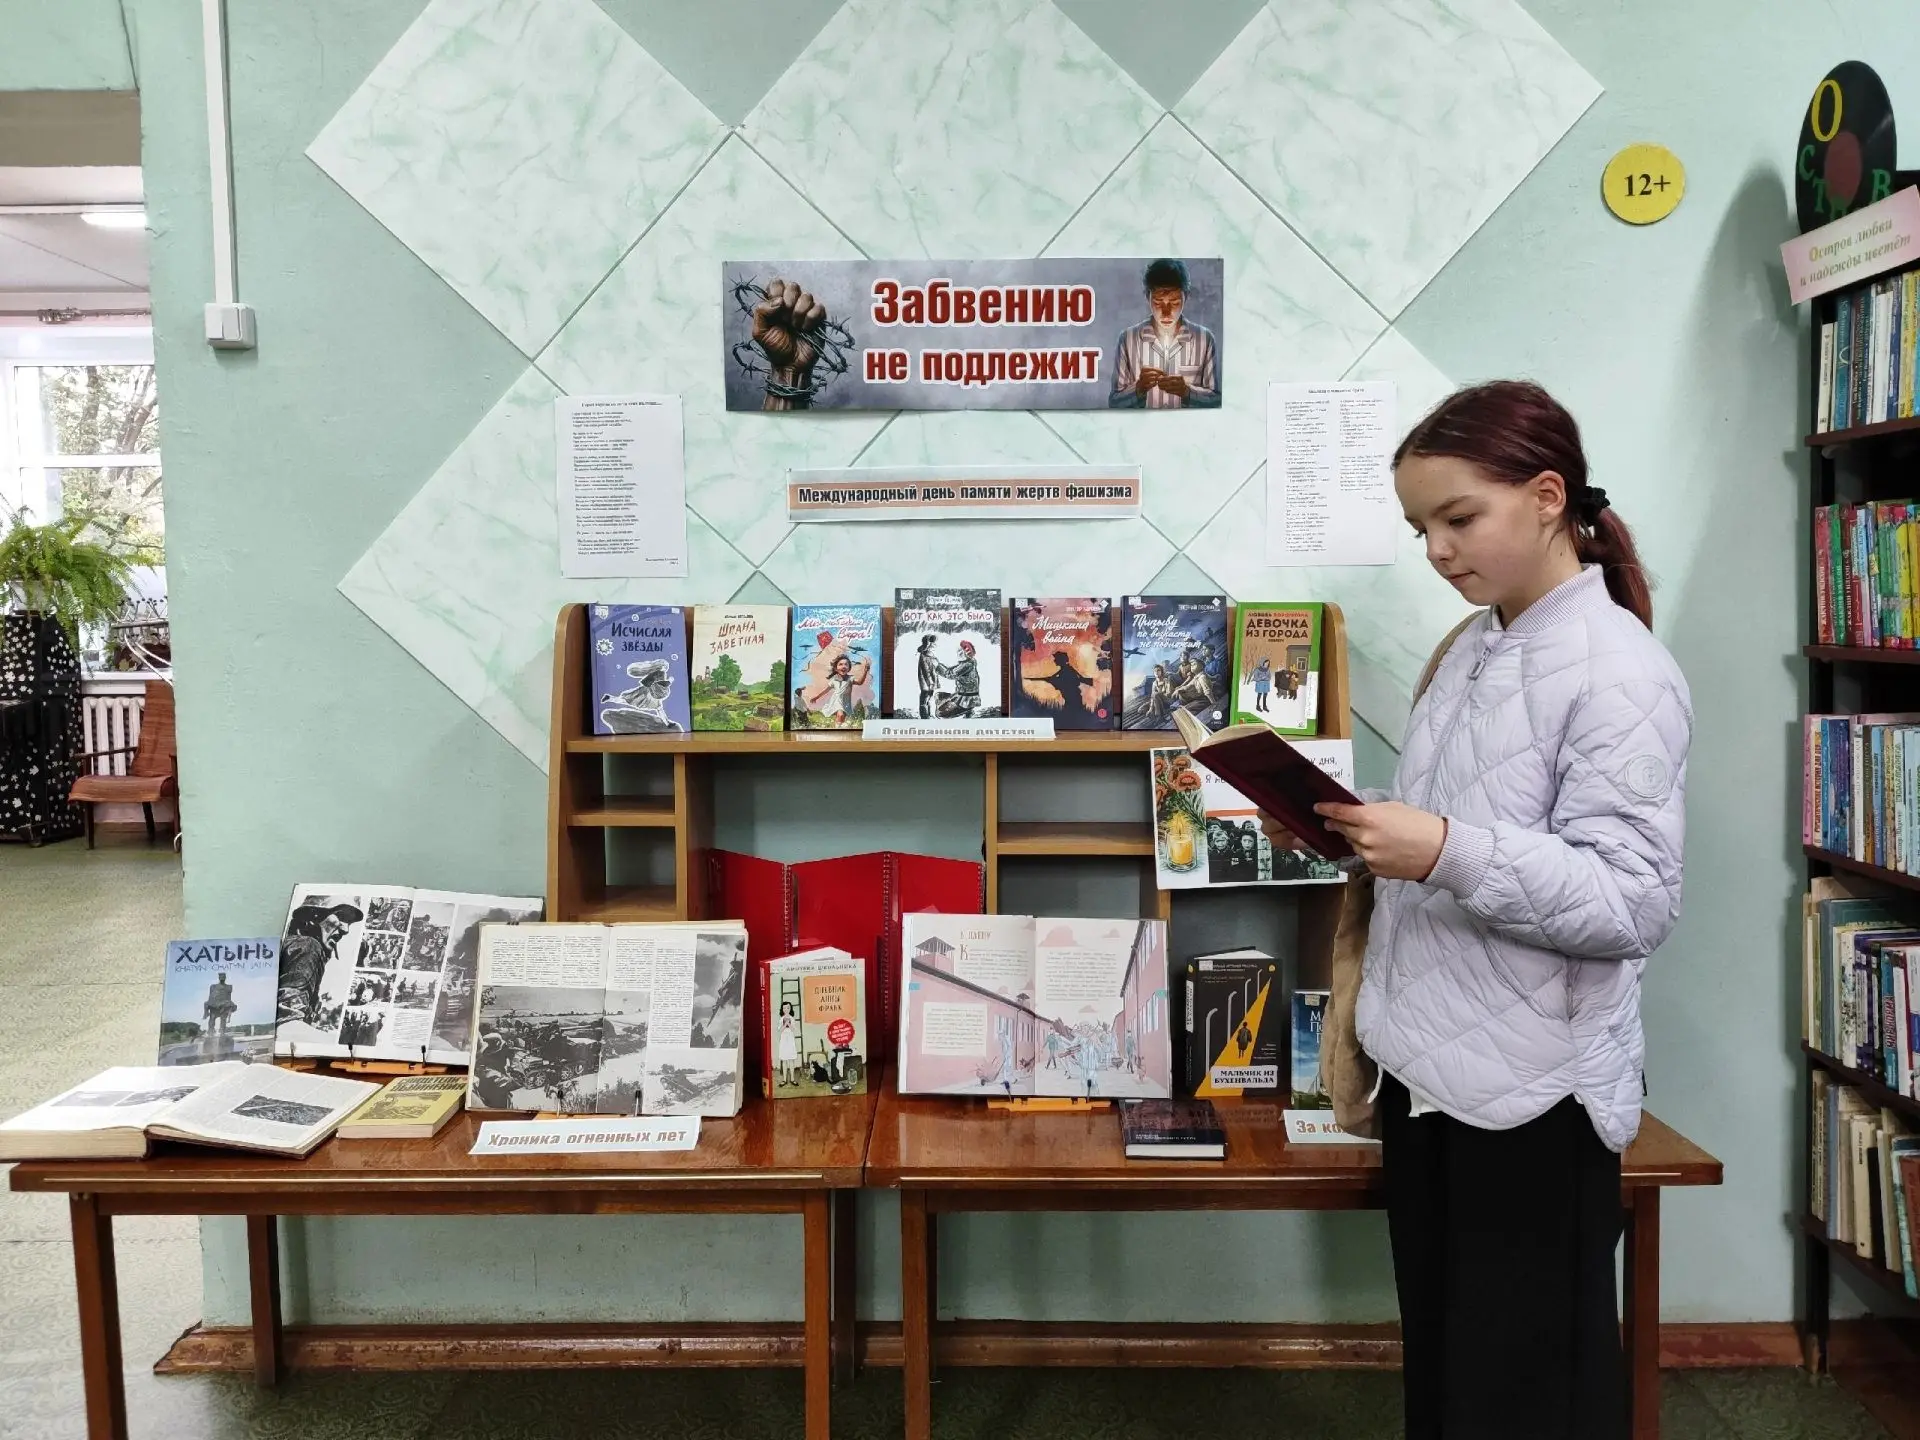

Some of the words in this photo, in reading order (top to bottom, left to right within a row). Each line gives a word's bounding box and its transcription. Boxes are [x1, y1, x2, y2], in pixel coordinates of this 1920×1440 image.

[1623, 173, 1671, 197] 12+
[1809, 236, 1852, 262] Остров
[1856, 220, 1892, 243] любви
[1800, 277, 1807, 287] и
[1810, 255, 1861, 283] надежды
[1864, 235, 1911, 262] цветёт
[873, 281, 1093, 324] Забвению
[866, 350, 907, 380] не
[922, 349, 1100, 385] подлежит
[799, 484, 917, 504] Международный
[921, 484, 956, 501] день
[959, 485, 1012, 500] памяти
[1016, 484, 1060, 500] жертв
[1065, 483, 1132, 500] фашизма
[903, 612, 923, 621] ВОТ
[927, 612, 943, 621] КАК
[946, 612, 964, 621] ЭТО
[967, 612, 992, 621] БЫЛО
[1032, 615, 1090, 631] Мишкина
[1132, 614, 1178, 630] Призыву
[1246, 619, 1309, 629] ДЕВОЧКА
[611, 622, 671, 638] Исчисляя
[1042, 631, 1075, 645] война
[1245, 629, 1260, 638] ИЗ
[1262, 629, 1309, 638] ГОРОДА
[1318, 756, 1338, 766] дня,
[1205, 775, 1212, 784] Я
[175, 943, 274, 963] ХАТЫНЬ
[174, 964, 207, 973] KHATYN
[211, 962, 245, 971] CHATYN
[814, 986, 846, 994] ДНЕВНИК
[1295, 1120, 1316, 1133] За
[488, 1133, 561, 1147] Хроника
[566, 1131, 651, 1144] огненных
[656, 1130, 687, 1142] лет
